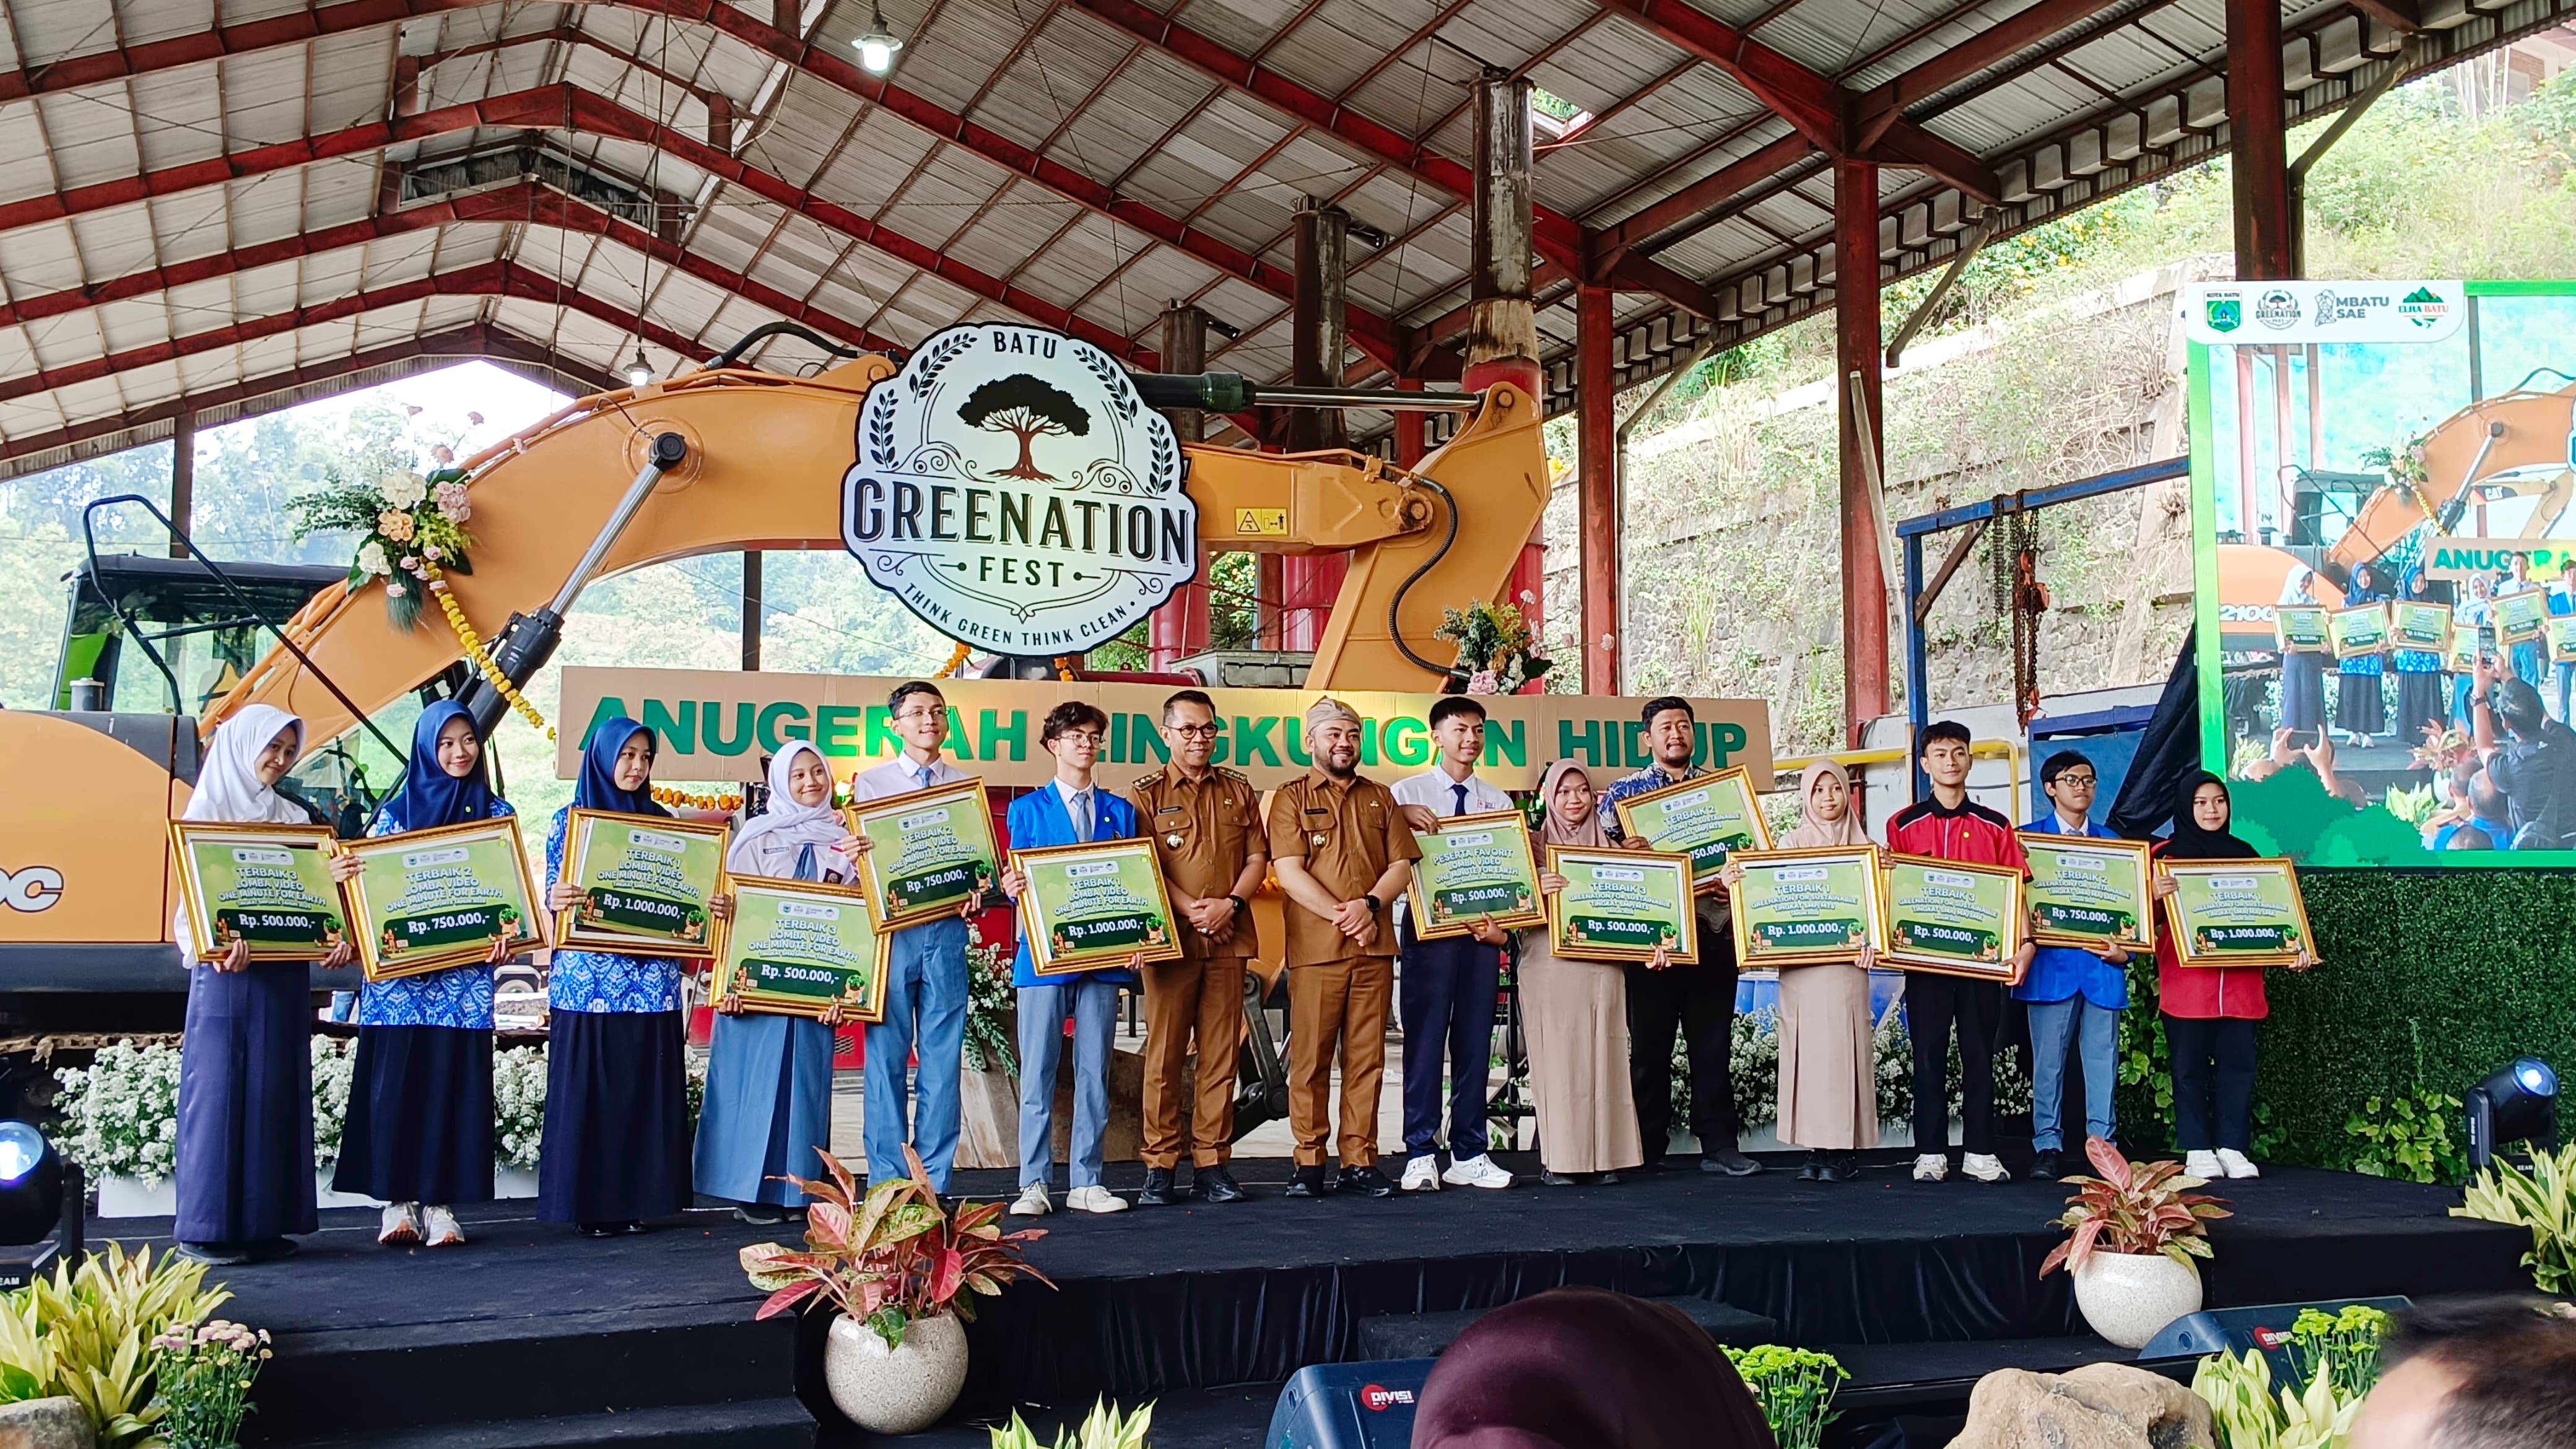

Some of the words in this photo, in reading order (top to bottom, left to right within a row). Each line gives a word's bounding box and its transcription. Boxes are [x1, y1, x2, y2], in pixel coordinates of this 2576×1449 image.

[2336, 297, 2390, 307] MBATU
[2337, 308, 2365, 318] SAE
[993, 331, 1057, 359] BATU
[2485, 485, 2503, 500] CAT
[853, 478, 1189, 567] GREENATION
[980, 556, 1064, 588] FEST
[905, 583, 952, 624] THINK
[958, 619, 1012, 644] GREEN
[1021, 629, 1074, 646] THINK
[1081, 606, 1127, 637] CLEAN
[1664, 807, 1706, 826] TERBAIK
[1708, 805, 1715, 814] 2
[902, 827, 944, 845] TERBAIK
[946, 826, 952, 835] 2
[902, 841, 931, 857] LOMBA
[933, 837, 958, 847] VIDEO
[627, 849, 675, 868] TERBAIK
[676, 859, 681, 869] 1
[888, 860, 905, 872] ONE
[905, 849, 934, 866] MINUTE
[936, 846, 952, 856] FOR
[952, 845, 977, 853] EARTH
[1433, 850, 1473, 866] PESERTA
[1474, 848, 1513, 857] FAVORIT
[1447, 859, 1476, 871] LOMBA
[1477, 857, 1502, 866] VIDEO
[237, 868, 287, 879] TERBAIK
[290, 871, 297, 880] 3
[406, 868, 461, 883] TERBAIK
[464, 866, 472, 876] 2
[619, 861, 654, 873] LOMBA
[655, 866, 684, 881] VIDEO
[1435, 874, 1451, 884] ONE
[1479, 867, 1495, 876] FOR
[1495, 867, 1518, 876] EARTH
[2055, 870, 2100, 882] TERBAIK
[2101, 876, 2108, 884] 2
[235, 879, 271, 889] LOMBA
[274, 881, 304, 891] VIDEO
[404, 881, 443, 896] LOMBA
[446, 878, 479, 889] VIDEO
[597, 871, 617, 881] ONE
[619, 870, 653, 882] MINUTE
[654, 876, 671, 887] FOR
[672, 882, 700, 899] EARTH
[906, 881, 924, 893] Rp.
[924, 869, 968, 887] 750.000,-
[1071, 877, 1115, 891] TERBAIK
[1116, 877, 1121, 886] 1
[1591, 882, 1637, 894] TERBAIK
[1775, 884, 1823, 895] TERBAIK
[1825, 884, 1830, 892] 1
[219, 891, 237, 902] ONE
[240, 889, 274, 899] MINUTE
[276, 890, 295, 899] FOR
[296, 893, 326, 906] EARTH
[386, 900, 407, 913] ONE
[408, 890, 446, 905] MINUTE
[449, 889, 469, 898] FOR
[471, 889, 502, 897] EARTH
[1068, 889, 1100, 902] LOMBA
[1100, 887, 1128, 897] VIDEO
[1451, 893, 1468, 904] Rp.
[1469, 888, 1510, 900] 500.000,-
[1921, 887, 1967, 900] TERBAIK
[1969, 893, 1975, 902] 3
[2211, 892, 2256, 902] TERBAIK
[2258, 892, 2263, 901] 1
[603, 894, 622, 909] Rp.
[625, 899, 685, 919] 1.000.000,-
[1054, 904, 1072, 916] ONE
[1072, 898, 1103, 910] MINUTE
[1104, 897, 1120, 905] FOR
[1121, 897, 1148, 906] EARTH
[238, 914, 259, 928] Rp.
[262, 915, 316, 928] 500.000,-
[407, 921, 430, 934] Rp.
[432, 912, 490, 929] 750.000,-
[2052, 907, 2069, 920] Rp.
[2070, 910, 2113, 924] 750.000,-
[776, 920, 827, 933] TERBAIK
[829, 926, 837, 935] 3
[1068, 926, 1087, 938] Rp.
[1088, 919, 1143, 934] 1.000.000,-
[1588, 920, 1605, 932] Rp.
[1607, 921, 1654, 934] 500.000,-
[1768, 926, 1786, 937] Rp.
[1788, 923, 1845, 934] 1.000.000,-
[1914, 925, 1931, 938] Rp.
[1933, 928, 1978, 943] 500.000,-
[2210, 929, 2227, 941] Rp.
[2229, 928, 2281, 939] 1.000.000,-
[770, 930, 807, 941] LOMBA
[809, 934, 840, 946] VIDEO
[748, 941, 768, 951] ONE
[771, 940, 806, 951] MINUTE
[808, 944, 826, 953] FOR
[829, 947, 858, 963] EARTH
[762, 965, 781, 979] Rp.
[784, 967, 839, 984] 500.000,-
[1370, 1390, 1412, 1401] DIVISI
